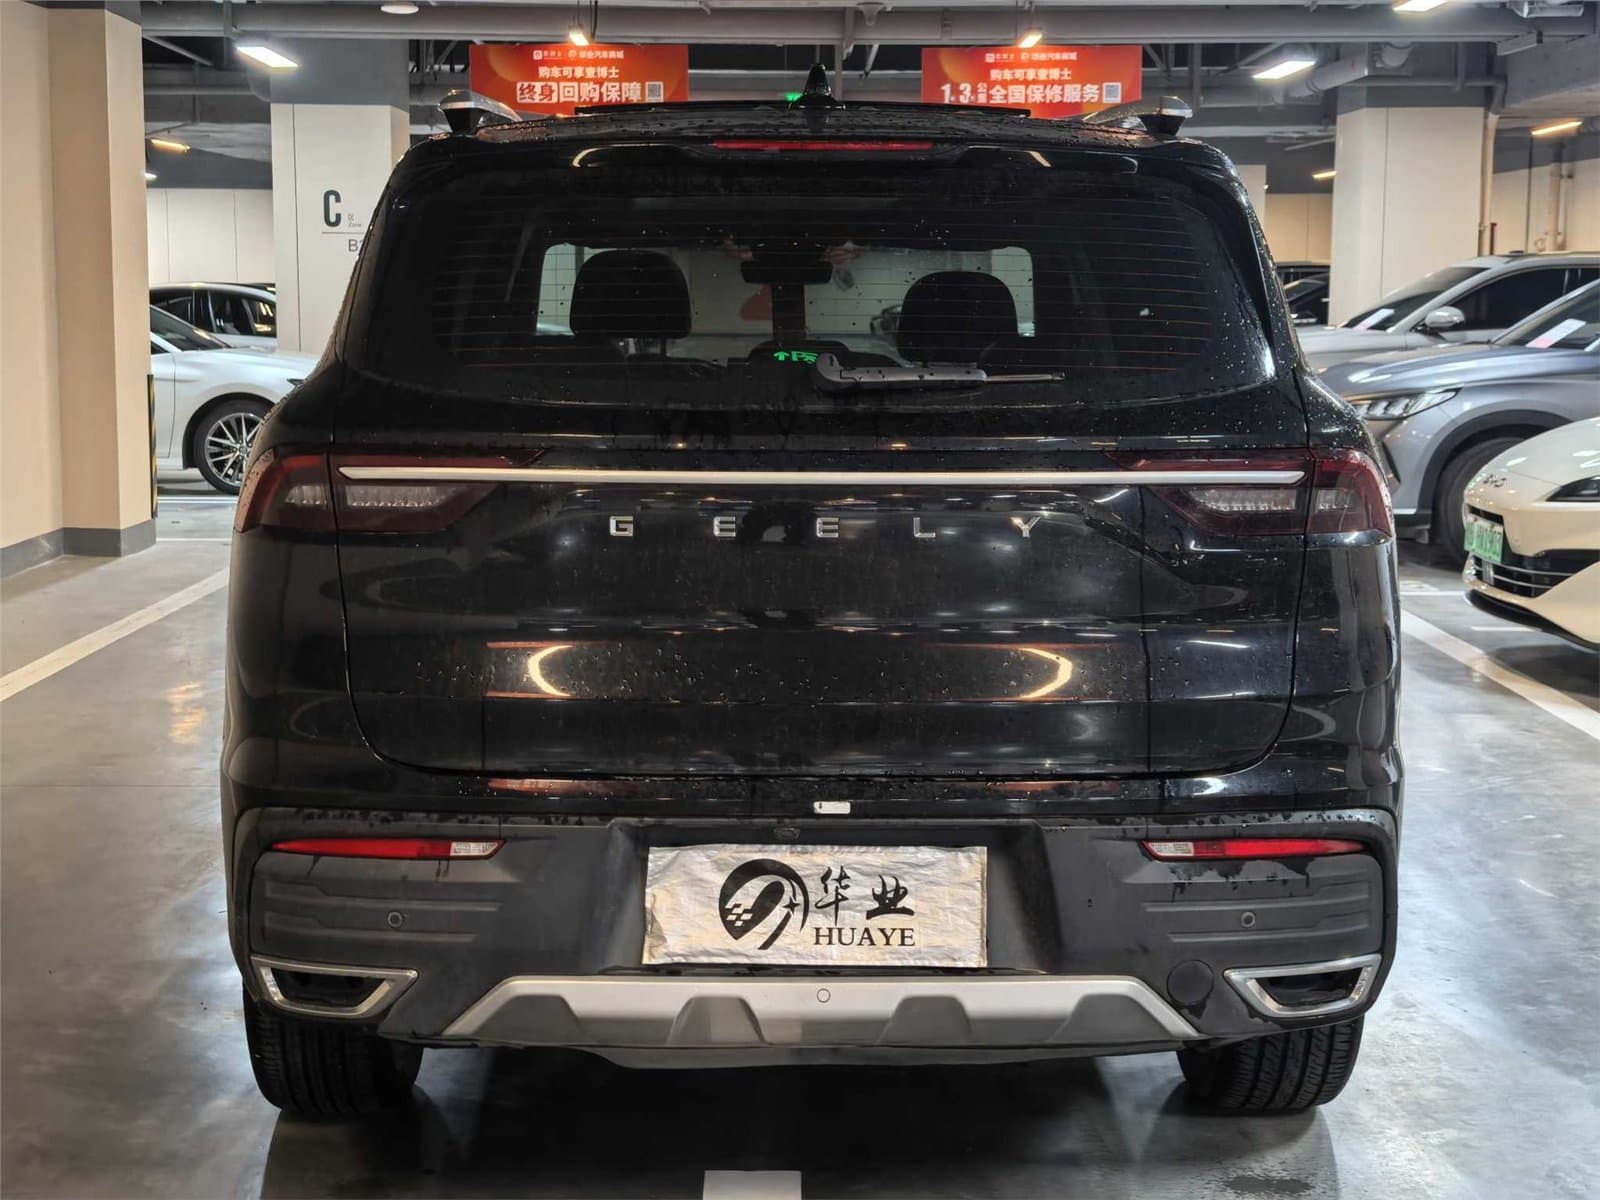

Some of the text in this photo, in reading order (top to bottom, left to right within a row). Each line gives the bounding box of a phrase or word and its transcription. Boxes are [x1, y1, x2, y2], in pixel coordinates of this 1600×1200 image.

[538, 66, 620, 78] 购车可享查博士
[517, 82, 641, 103] 终身回购保障
[323, 189, 342, 227] C
[609, 515, 1041, 538] GEELY
[814, 865, 915, 926] 华业
[813, 927, 916, 947] HUAYE
